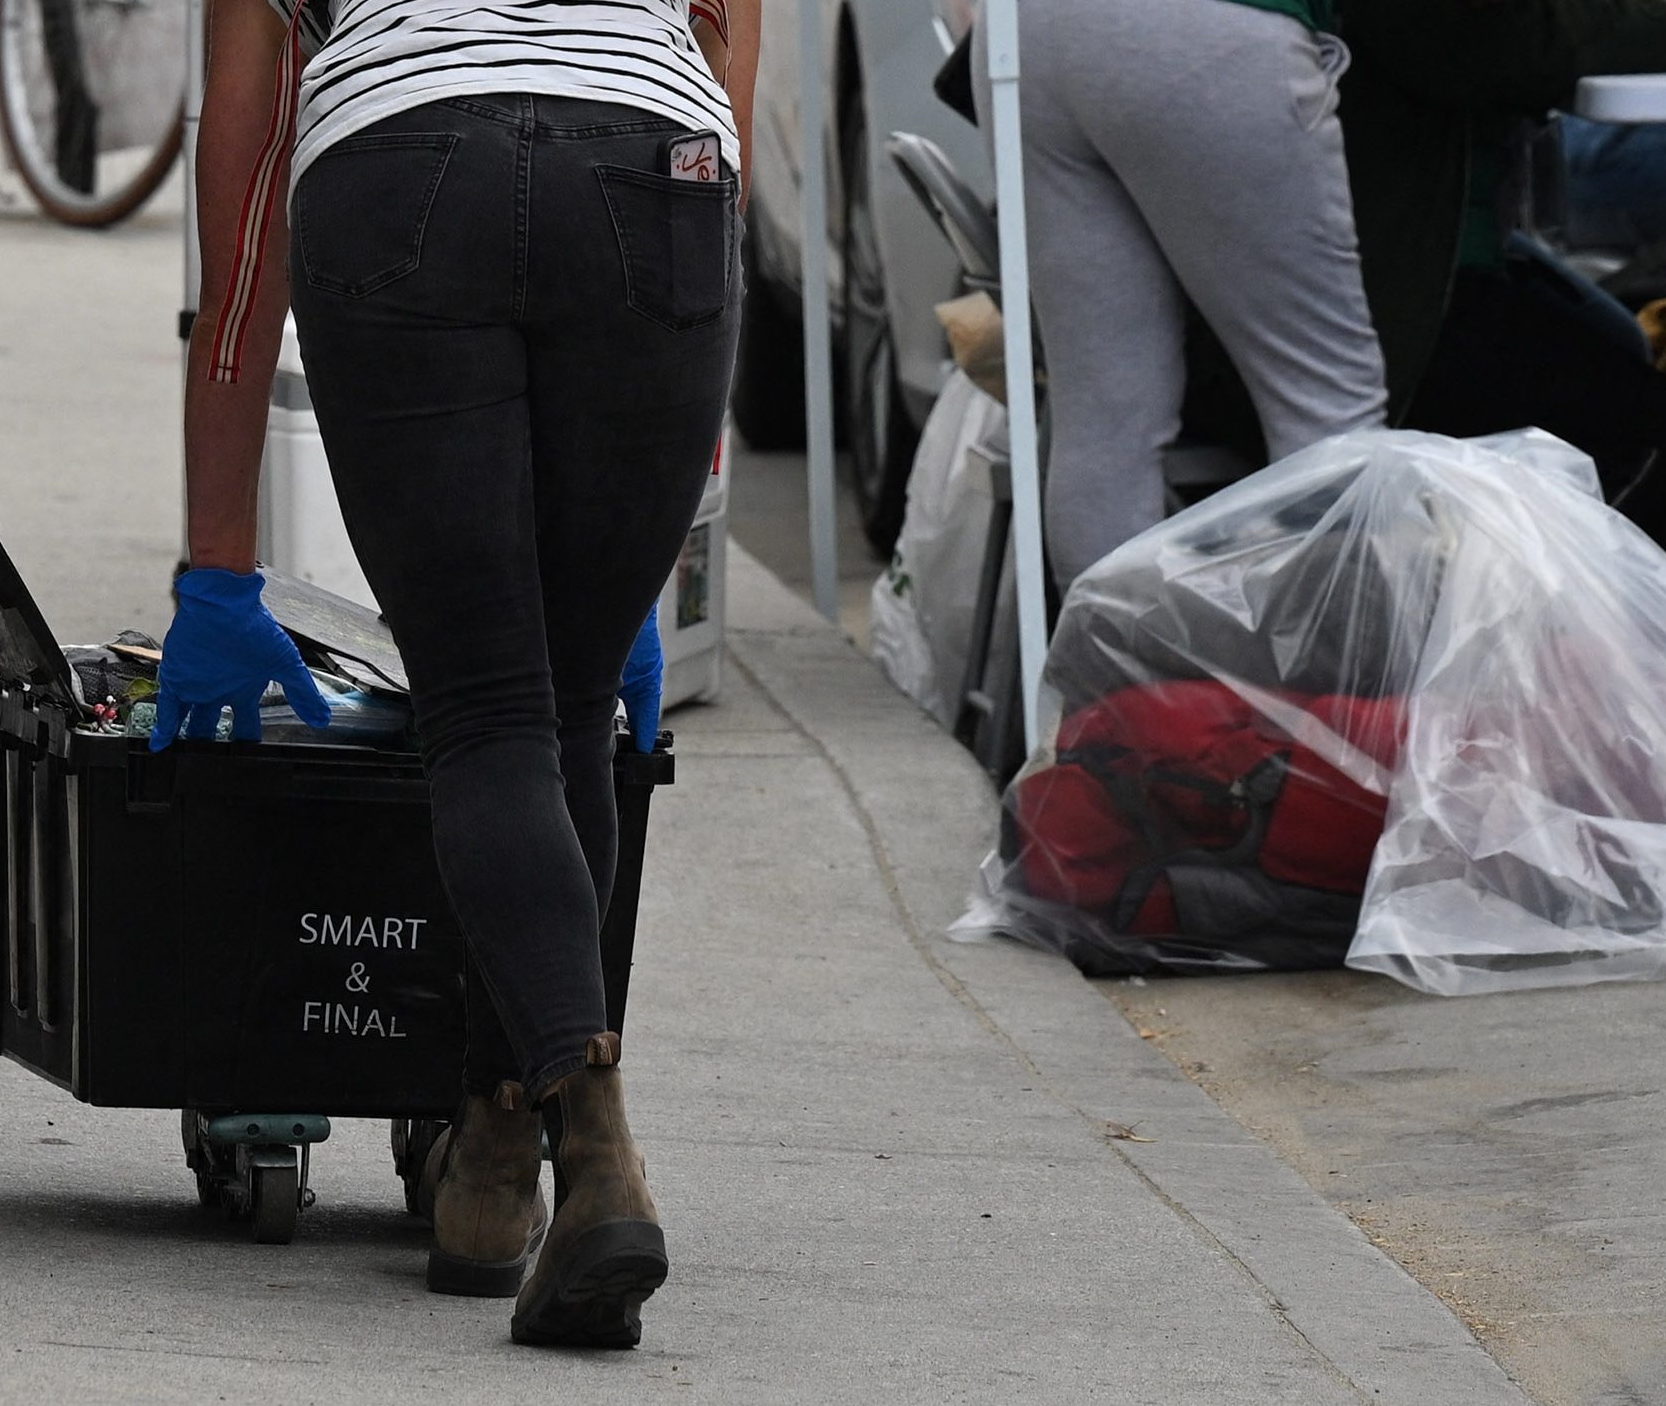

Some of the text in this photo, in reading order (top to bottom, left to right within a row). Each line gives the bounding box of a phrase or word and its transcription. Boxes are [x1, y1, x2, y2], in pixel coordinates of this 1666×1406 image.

[299, 913, 428, 950] SMART
[345, 961, 371, 993] &
[303, 1001, 407, 1038] FINAL
